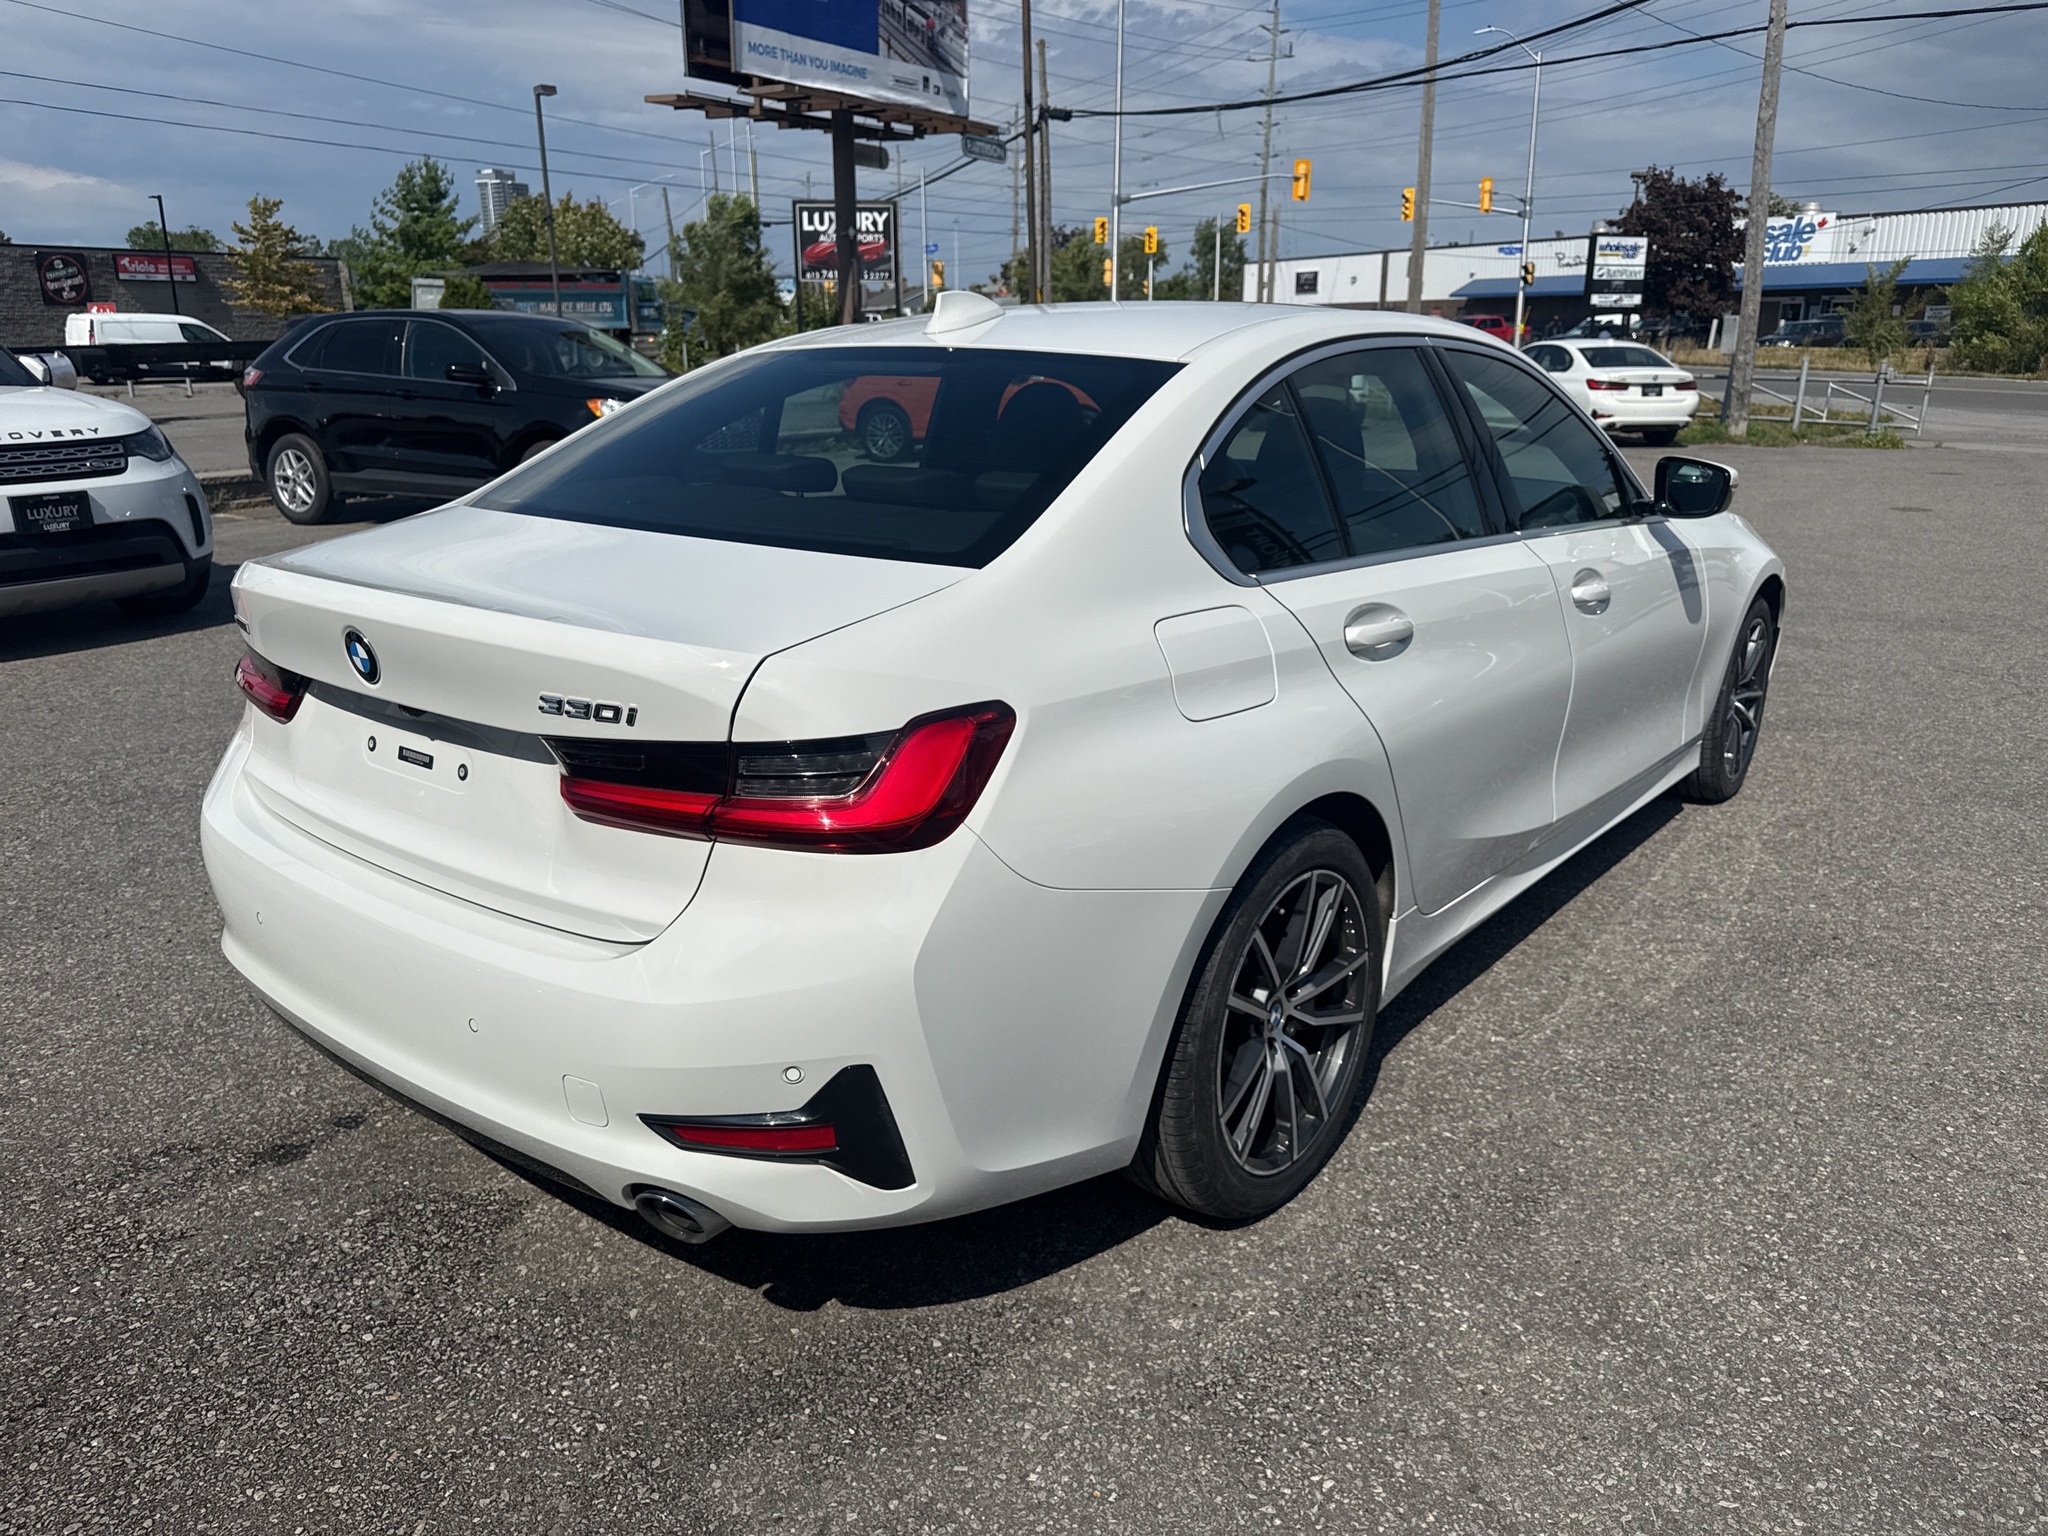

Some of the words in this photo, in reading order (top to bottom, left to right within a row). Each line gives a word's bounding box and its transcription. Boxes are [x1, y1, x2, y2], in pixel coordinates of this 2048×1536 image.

[748, 41, 778, 59] MORE
[780, 48, 807, 66] THAN
[808, 56, 829, 70] YOU
[830, 61, 867, 79] IMAGINE
[1765, 217, 1816, 244] sale
[819, 234, 837, 243] AUT
[540, 301, 574, 313] MAUICE
[0, 427, 99, 440] OVERY
[26, 504, 79, 521] LUXURY
[43, 522, 70, 531] LUXURY
[538, 692, 638, 727] 330i
